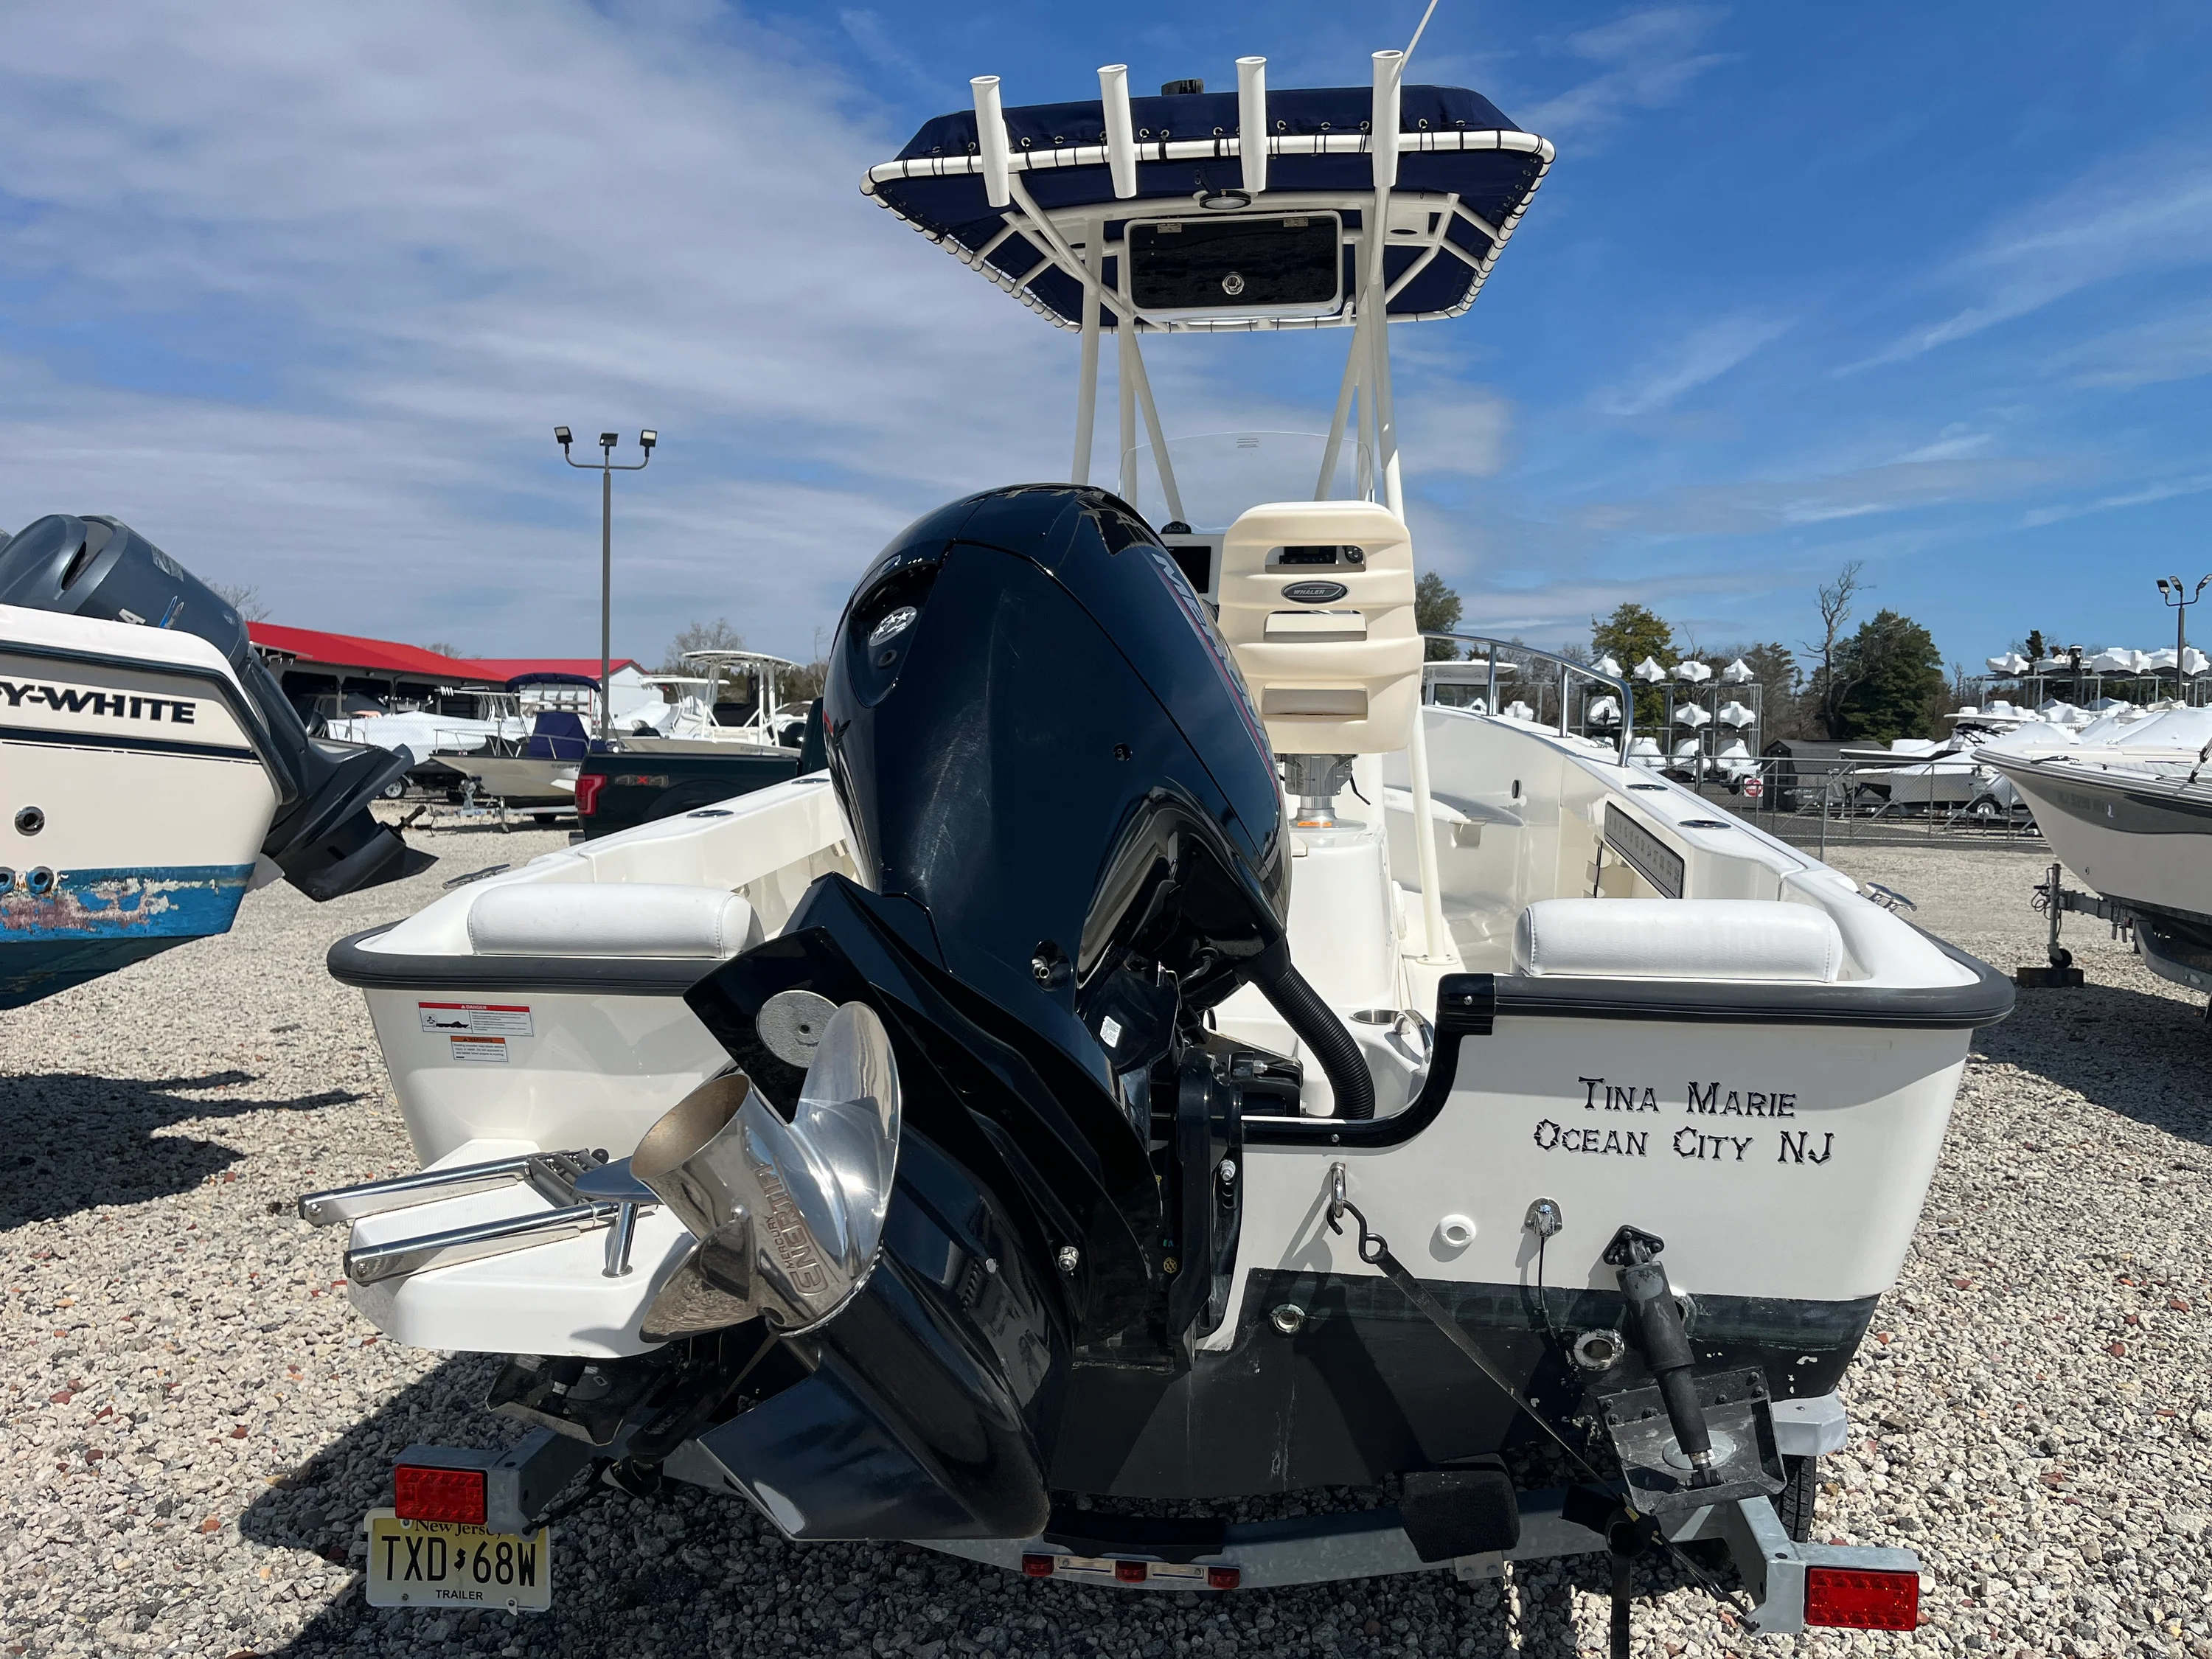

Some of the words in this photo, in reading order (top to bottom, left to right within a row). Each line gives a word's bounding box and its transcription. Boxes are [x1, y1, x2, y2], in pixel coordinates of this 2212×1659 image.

[1152, 552, 1279, 782] MERCUR
[0, 682, 196, 725] Y-WHITE
[1777, 1130, 1835, 1166] NJ
[764, 1215, 795, 1270] MERCURY
[414, 1519, 453, 1533] New
[454, 1522, 502, 1540] Jers
[381, 1535, 448, 1582] TXD
[472, 1540, 537, 1587] 68W
[435, 1589, 484, 1601] TRAILER
